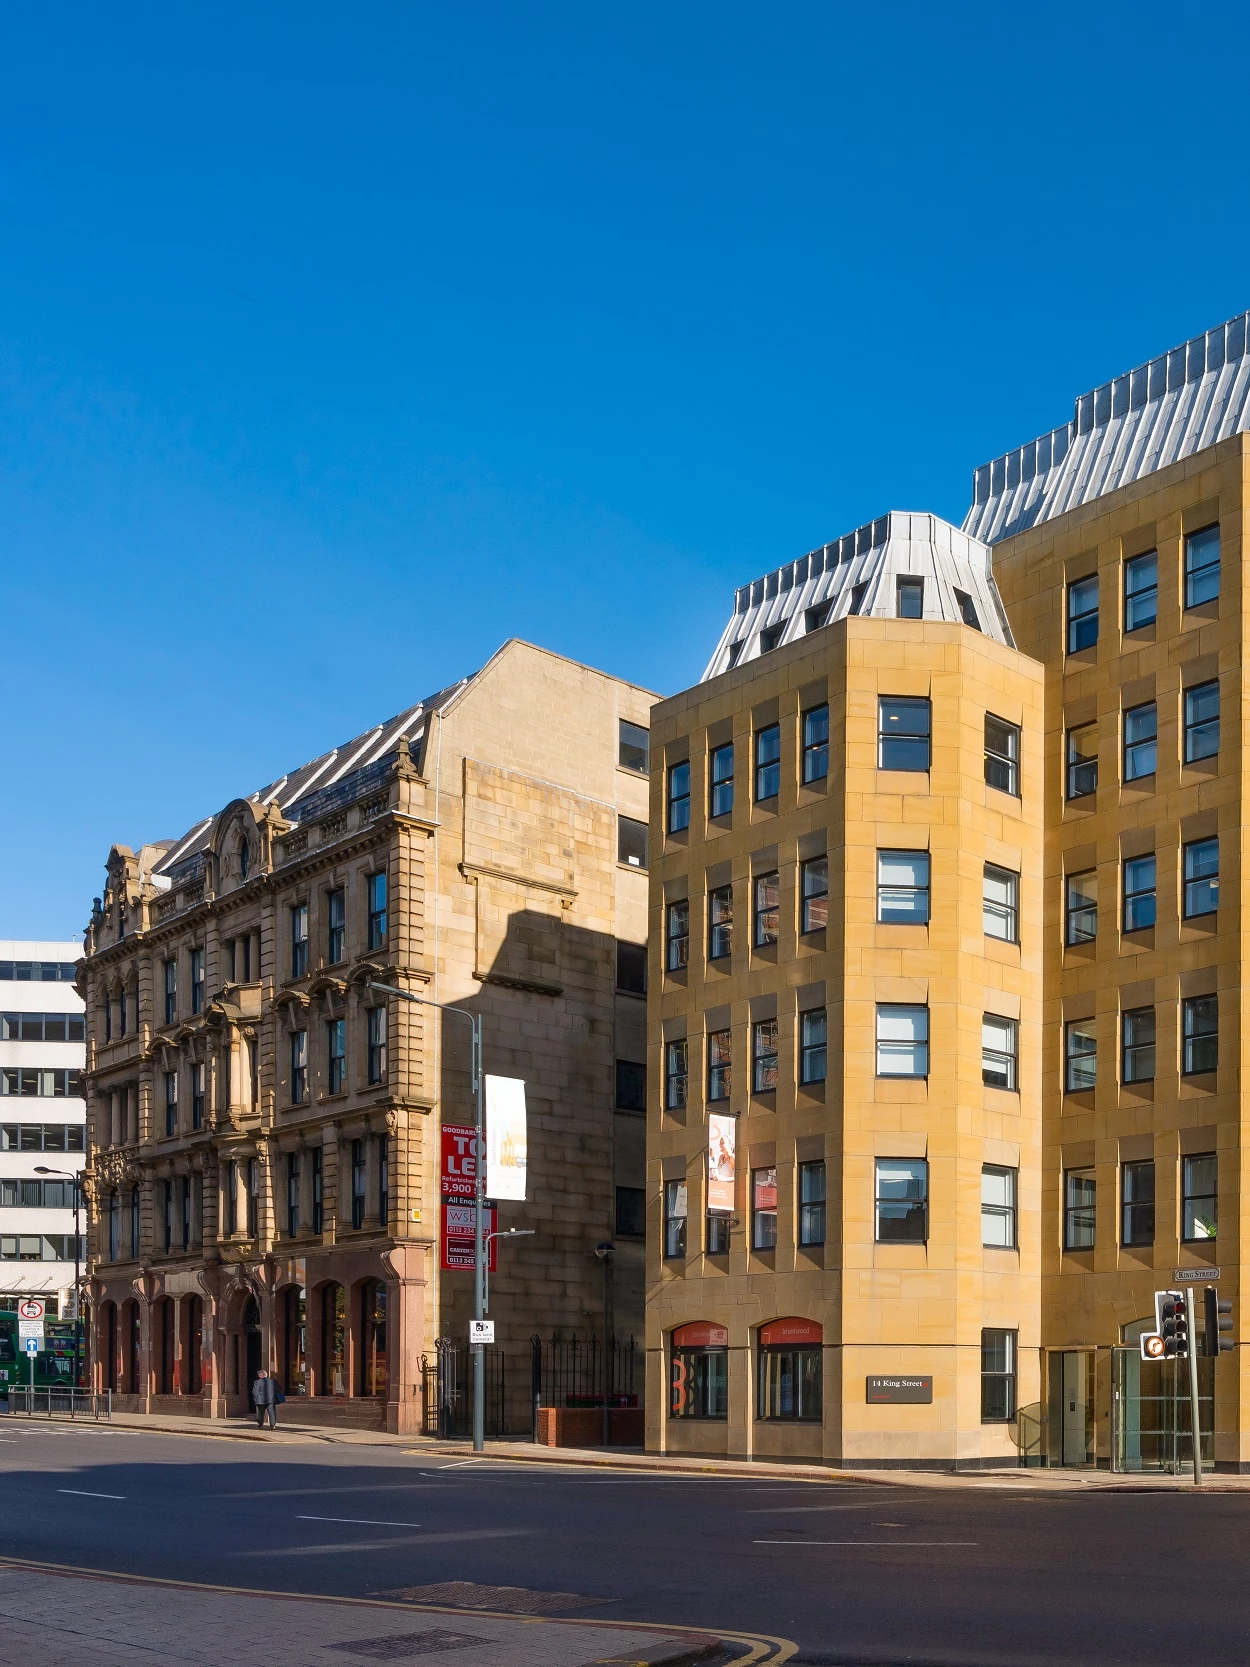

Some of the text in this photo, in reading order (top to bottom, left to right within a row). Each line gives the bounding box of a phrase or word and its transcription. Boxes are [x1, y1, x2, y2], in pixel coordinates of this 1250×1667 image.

[453, 1136, 486, 1156] TO
[442, 1182, 471, 1194] 3,900
[459, 1197, 491, 1207] Enques
[1178, 1270, 1216, 1279] KING STREET
[883, 1380, 900, 1388] King
